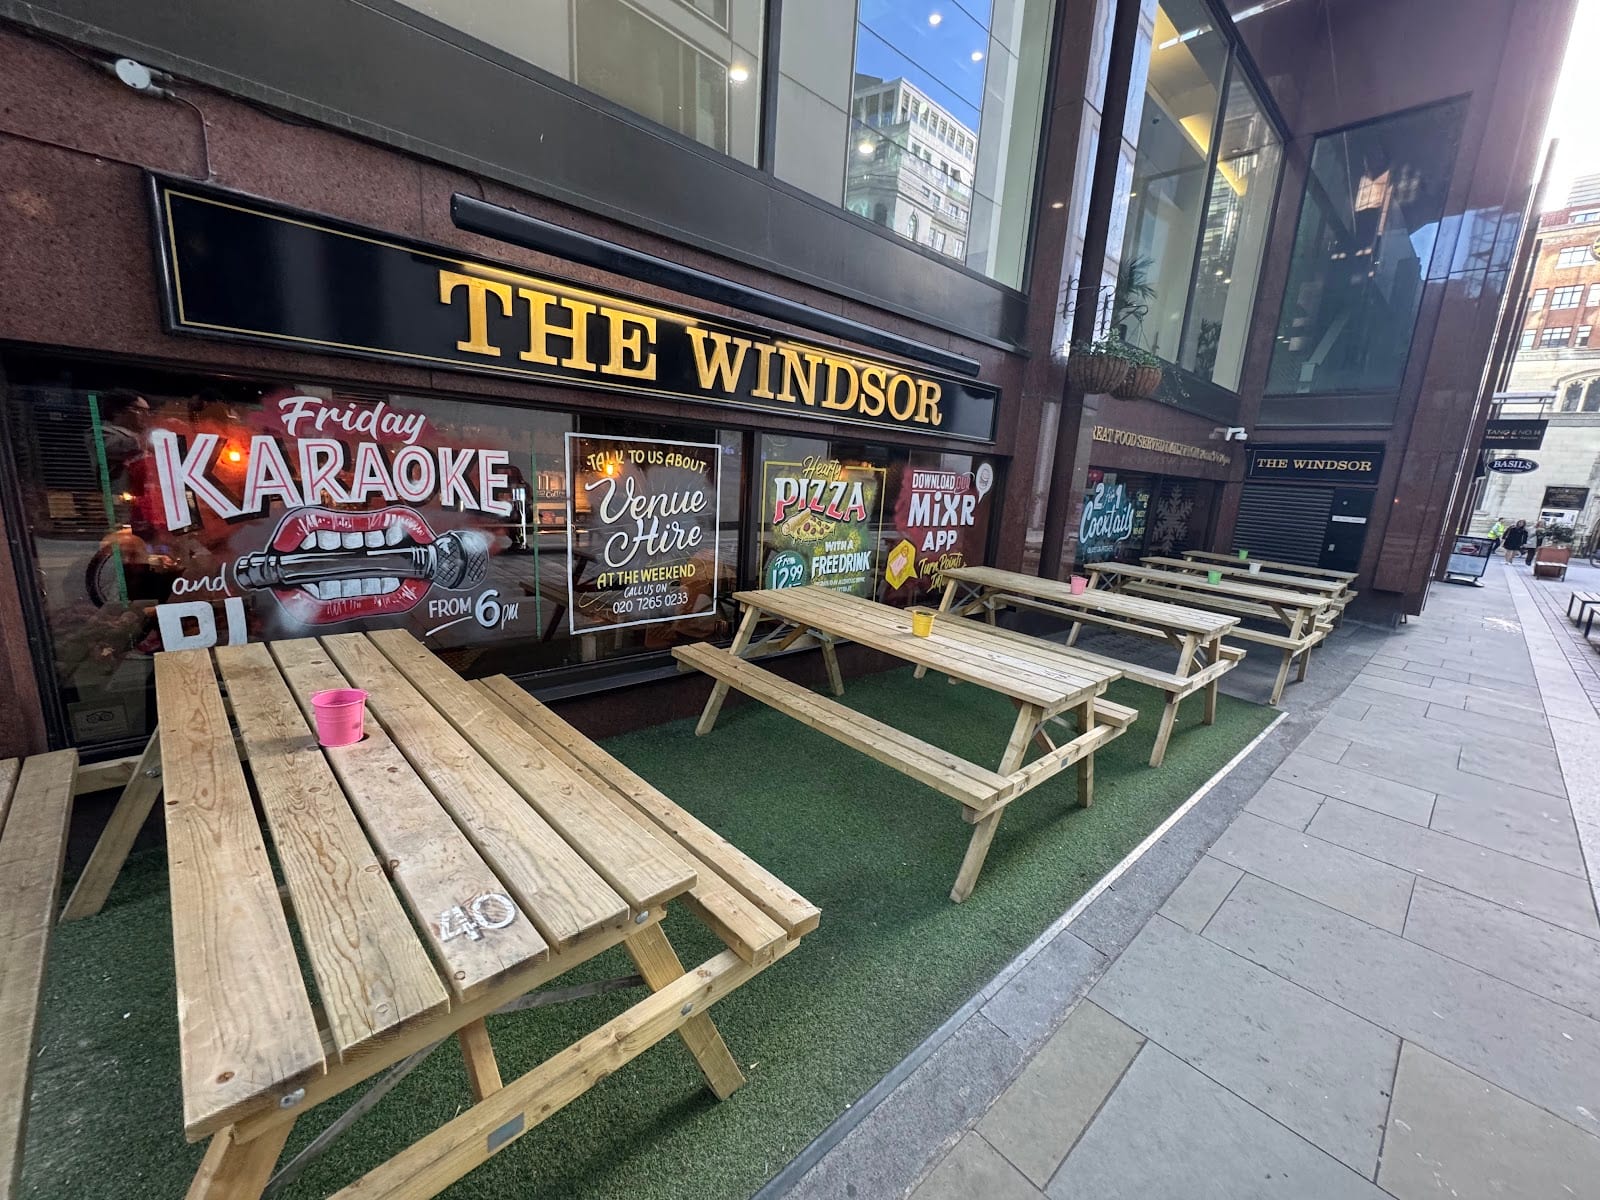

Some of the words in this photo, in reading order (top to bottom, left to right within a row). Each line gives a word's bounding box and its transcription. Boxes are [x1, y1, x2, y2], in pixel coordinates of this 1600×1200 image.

[439, 269, 657, 381] THE
[684, 325, 943, 426] WINDSOR
[278, 395, 426, 445] Friday
[1114, 429, 1137, 447] FOOD
[587, 449, 624, 472] TALK
[628, 450, 645, 464] TO
[647, 450, 664, 465] US
[665, 452, 707, 474] ABOUT
[802, 455, 842, 482] Hearty
[1256, 458, 1289, 469] THE
[1293, 459, 1372, 471] WINDSOR
[1493, 460, 1533, 470] BASILS
[151, 430, 514, 532] KARAOKE
[911, 472, 955, 490] DOWNLOAD
[584, 476, 708, 524] Venue
[773, 477, 867, 524] PIZZA
[1093, 482, 1105, 510] 2
[1115, 484, 1123, 509] 1
[1079, 501, 1135, 544] Cocktails
[604, 515, 703, 568] Hire
[824, 540, 846, 553] WITH
[845, 539, 854, 550] A
[921, 530, 958, 553] APP
[596, 572, 615, 590] AT
[616, 569, 639, 586] THE
[640, 563, 696, 583] WEEKEND
[811, 554, 840, 579] FREE
[839, 550, 872, 574] DRINK
[918, 557, 939, 579] Turn
[172, 562, 232, 597] and
[624, 586, 642, 599] CALL
[643, 584, 654, 596] US
[656, 582, 668, 593] ON
[927, 573, 945, 593] Int
[429, 596, 472, 619] FROM
[612, 599, 633, 614] 020
[636, 595, 662, 611] 7265
[664, 591, 689, 607] 0233
[440, 892, 516, 942] 40
